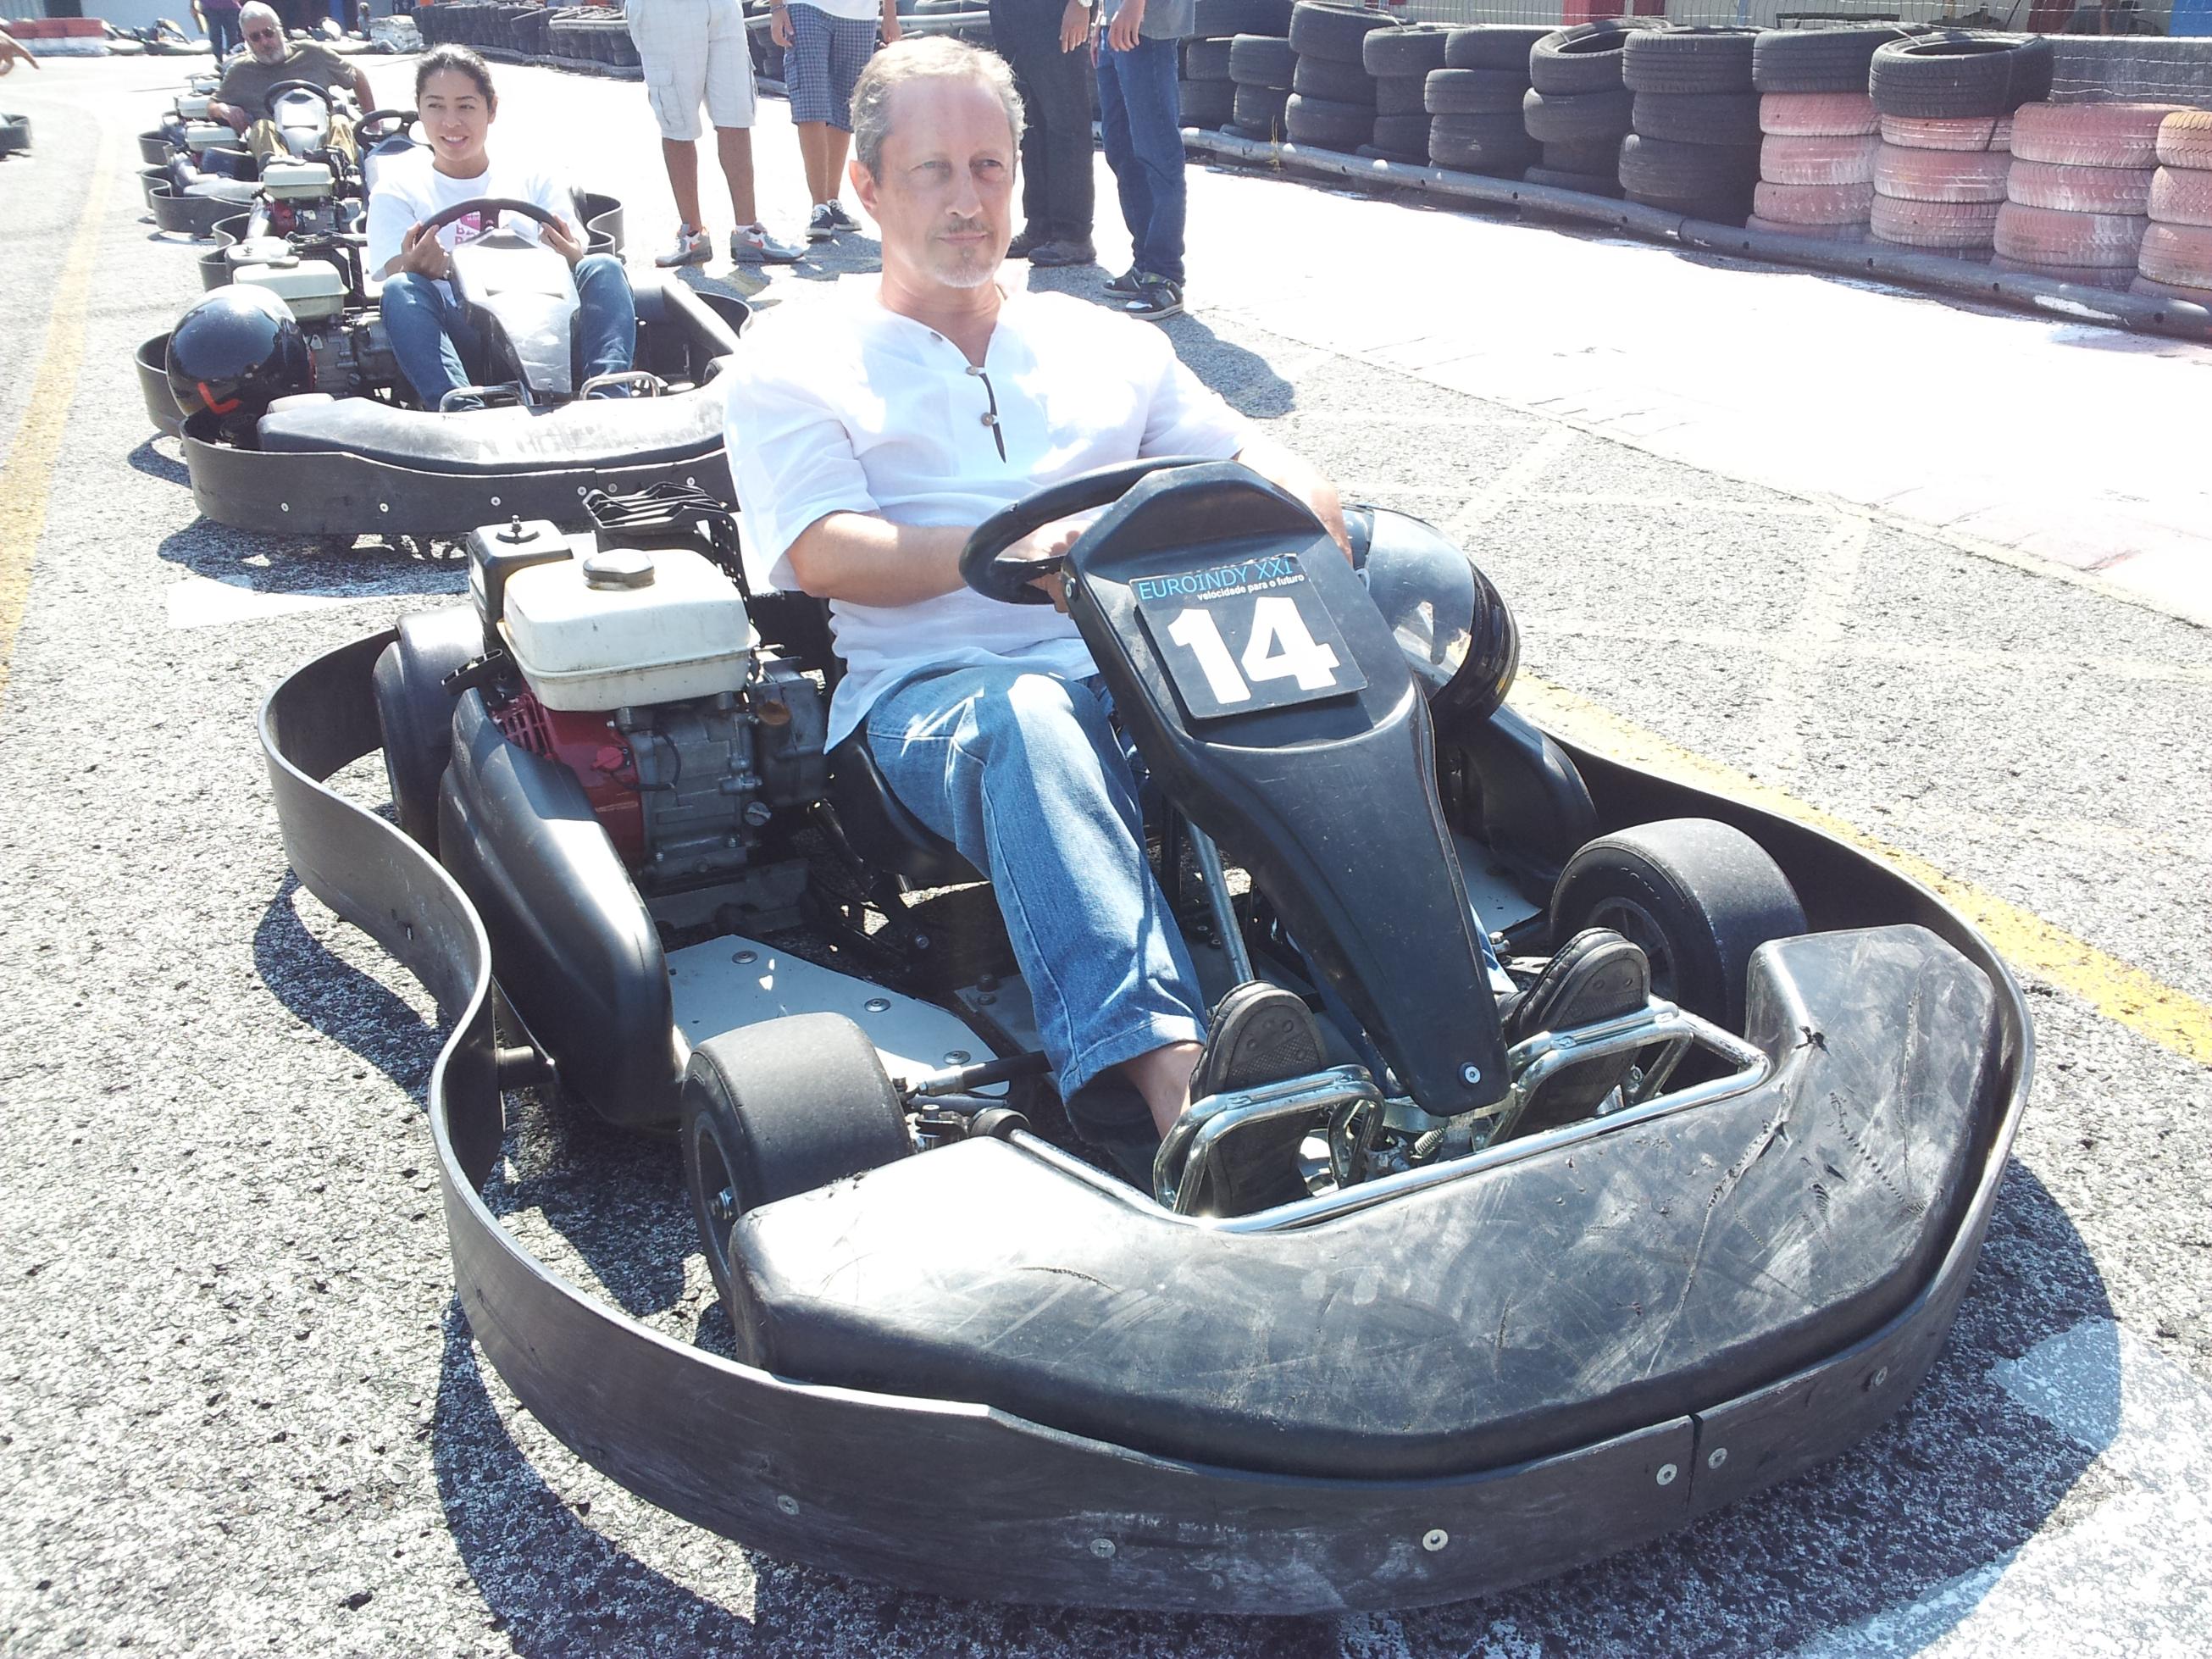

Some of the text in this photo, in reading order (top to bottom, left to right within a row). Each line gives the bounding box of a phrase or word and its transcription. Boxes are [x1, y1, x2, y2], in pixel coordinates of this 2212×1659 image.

[1138, 558, 1294, 600] EUROINDY XXI
[1196, 574, 1305, 601] velocidade para o futuro
[1167, 596, 1340, 704] 14
